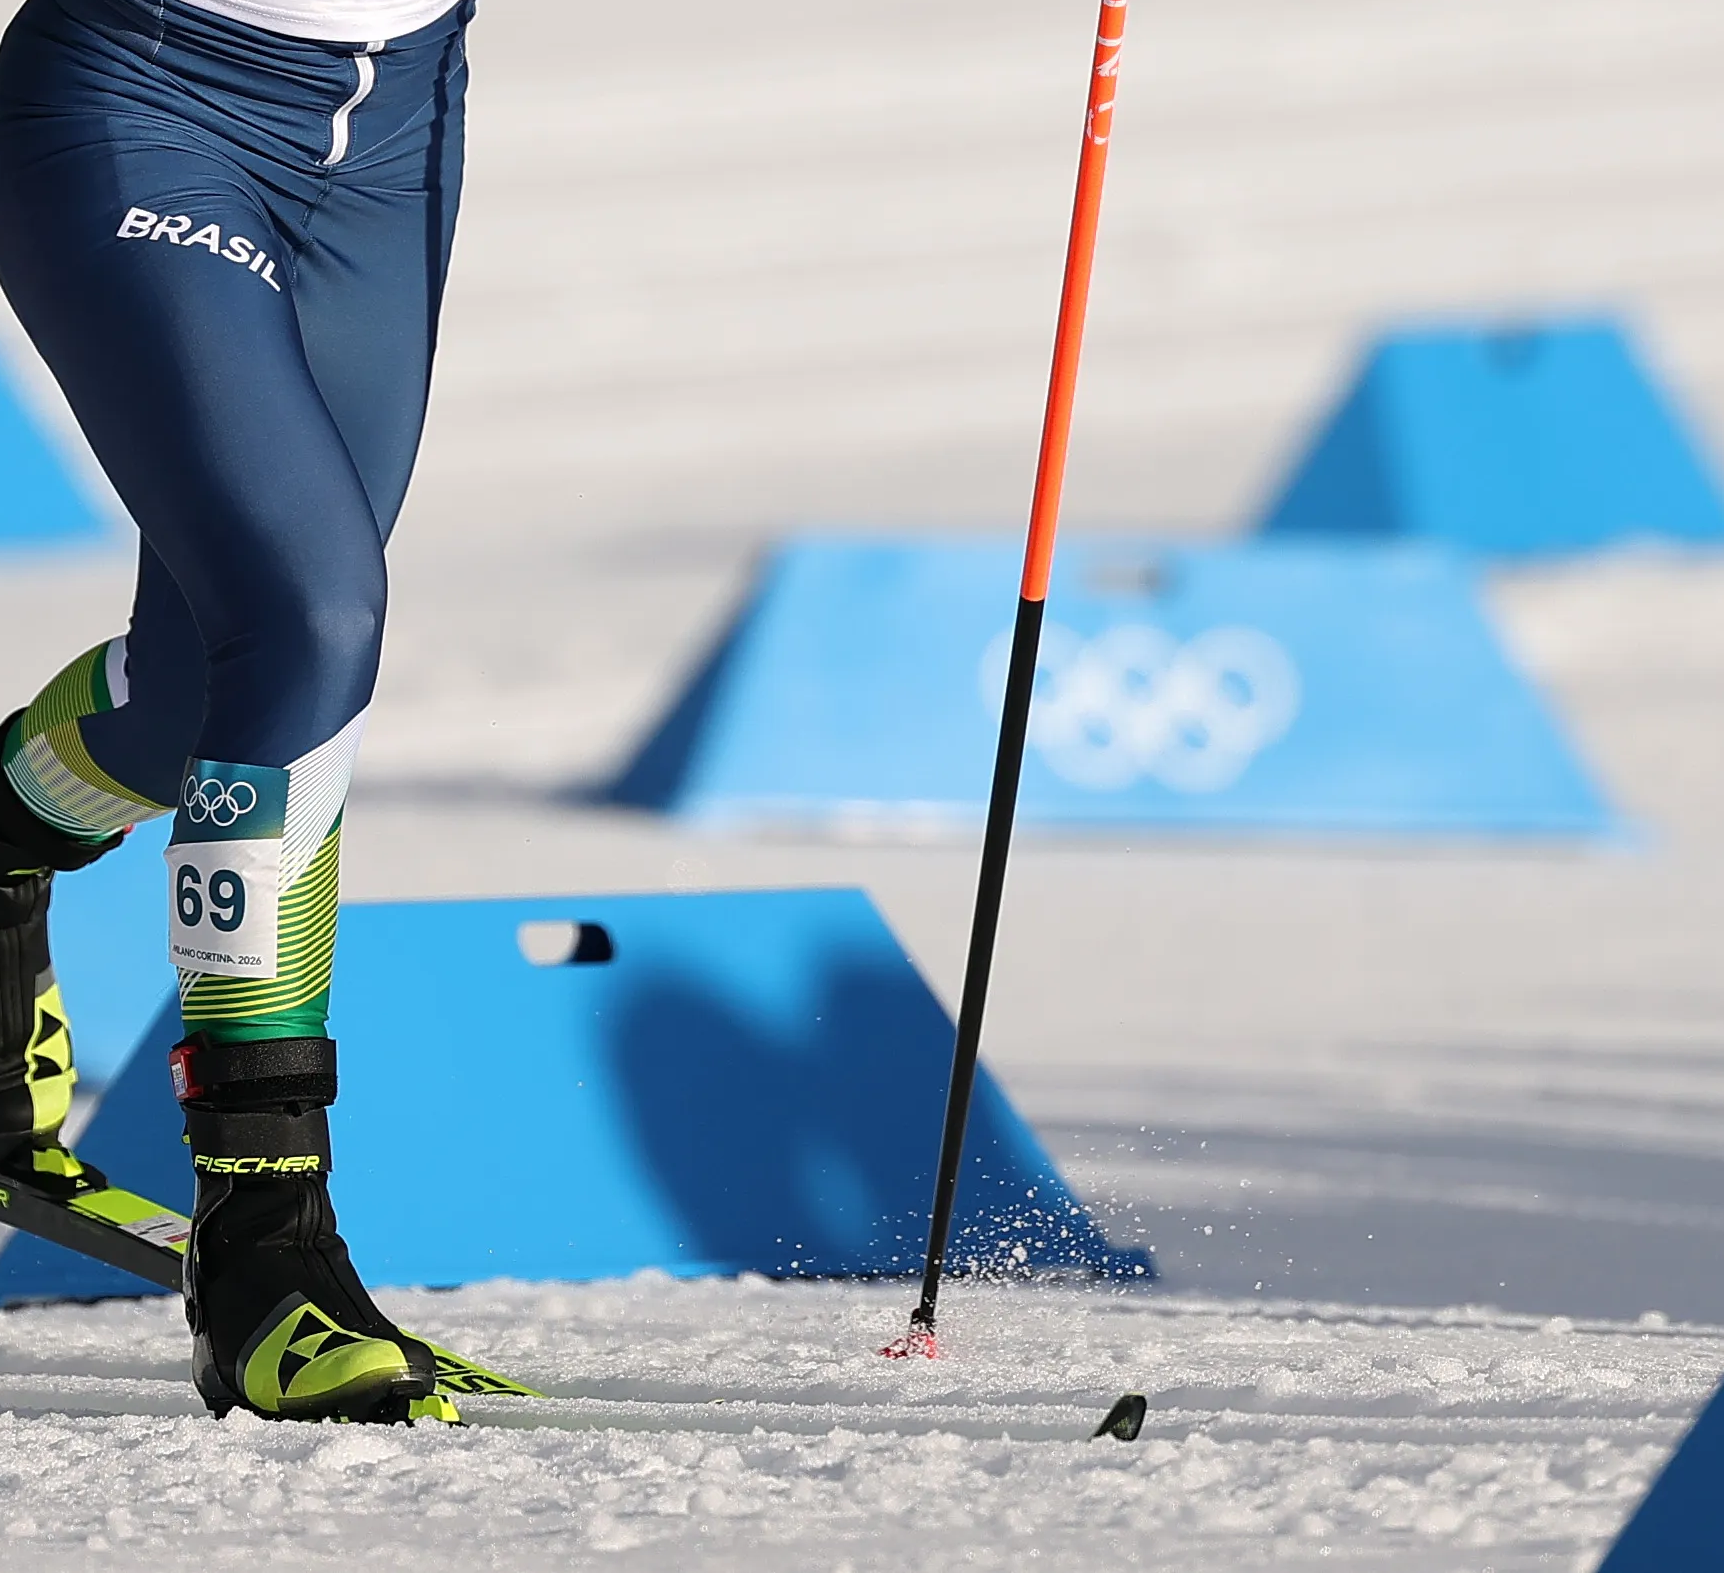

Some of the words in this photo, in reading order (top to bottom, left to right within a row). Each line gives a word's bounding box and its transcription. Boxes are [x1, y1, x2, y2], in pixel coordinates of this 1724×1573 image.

[115, 206, 282, 293] BRASIL
[176, 863, 246, 933] 69
[195, 950, 236, 964] CORTINA
[237, 955, 262, 966] 2026
[194, 1154, 321, 1174] FISCHER
